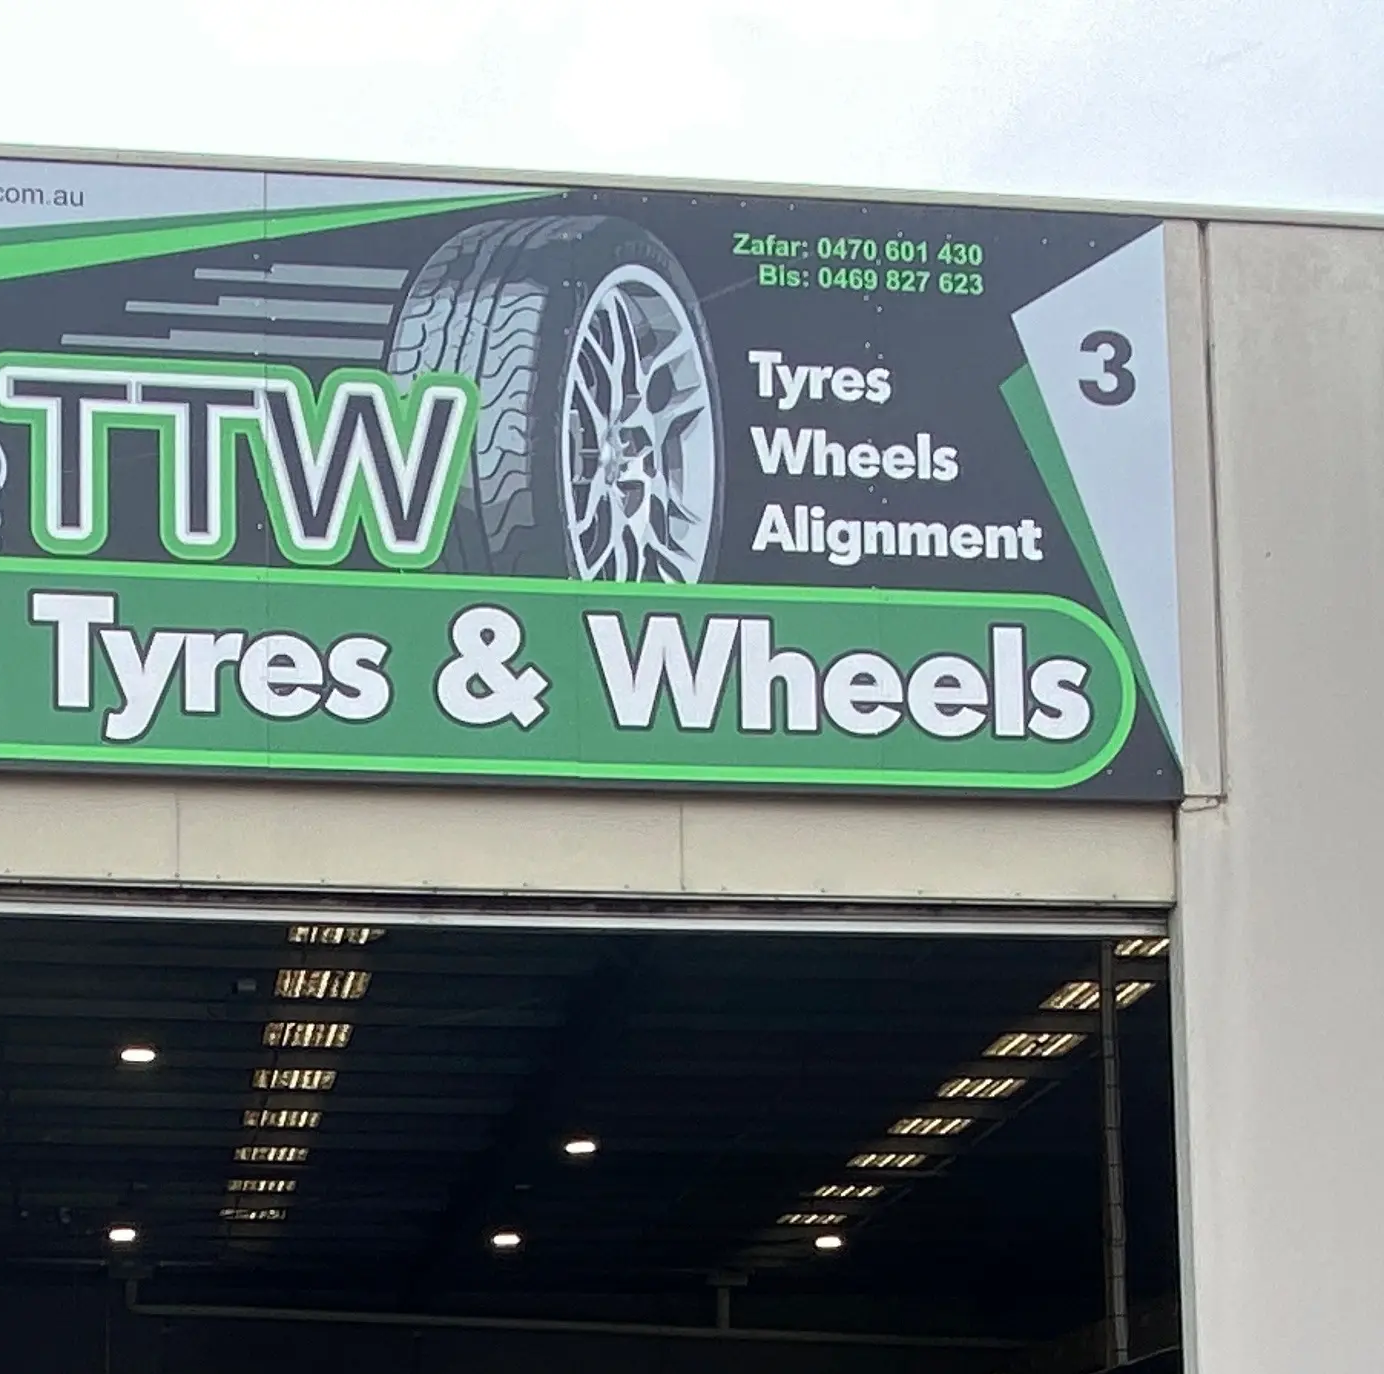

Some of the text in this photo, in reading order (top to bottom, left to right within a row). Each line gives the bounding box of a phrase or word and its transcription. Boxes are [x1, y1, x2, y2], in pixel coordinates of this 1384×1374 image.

[733, 233, 983, 266] Zafar: 0470 601 430
[818, 267, 878, 291] 0469
[886, 270, 931, 293] 827
[939, 273, 984, 296] 623
[748, 350, 892, 410] Tyres
[1079, 331, 1137, 406] 3
[750, 427, 960, 482] Wheels
[752, 504, 1043, 566] Alignment
[31, 593, 389, 742] Tyres
[437, 606, 548, 728] &
[585, 613, 1091, 740] Wheels
